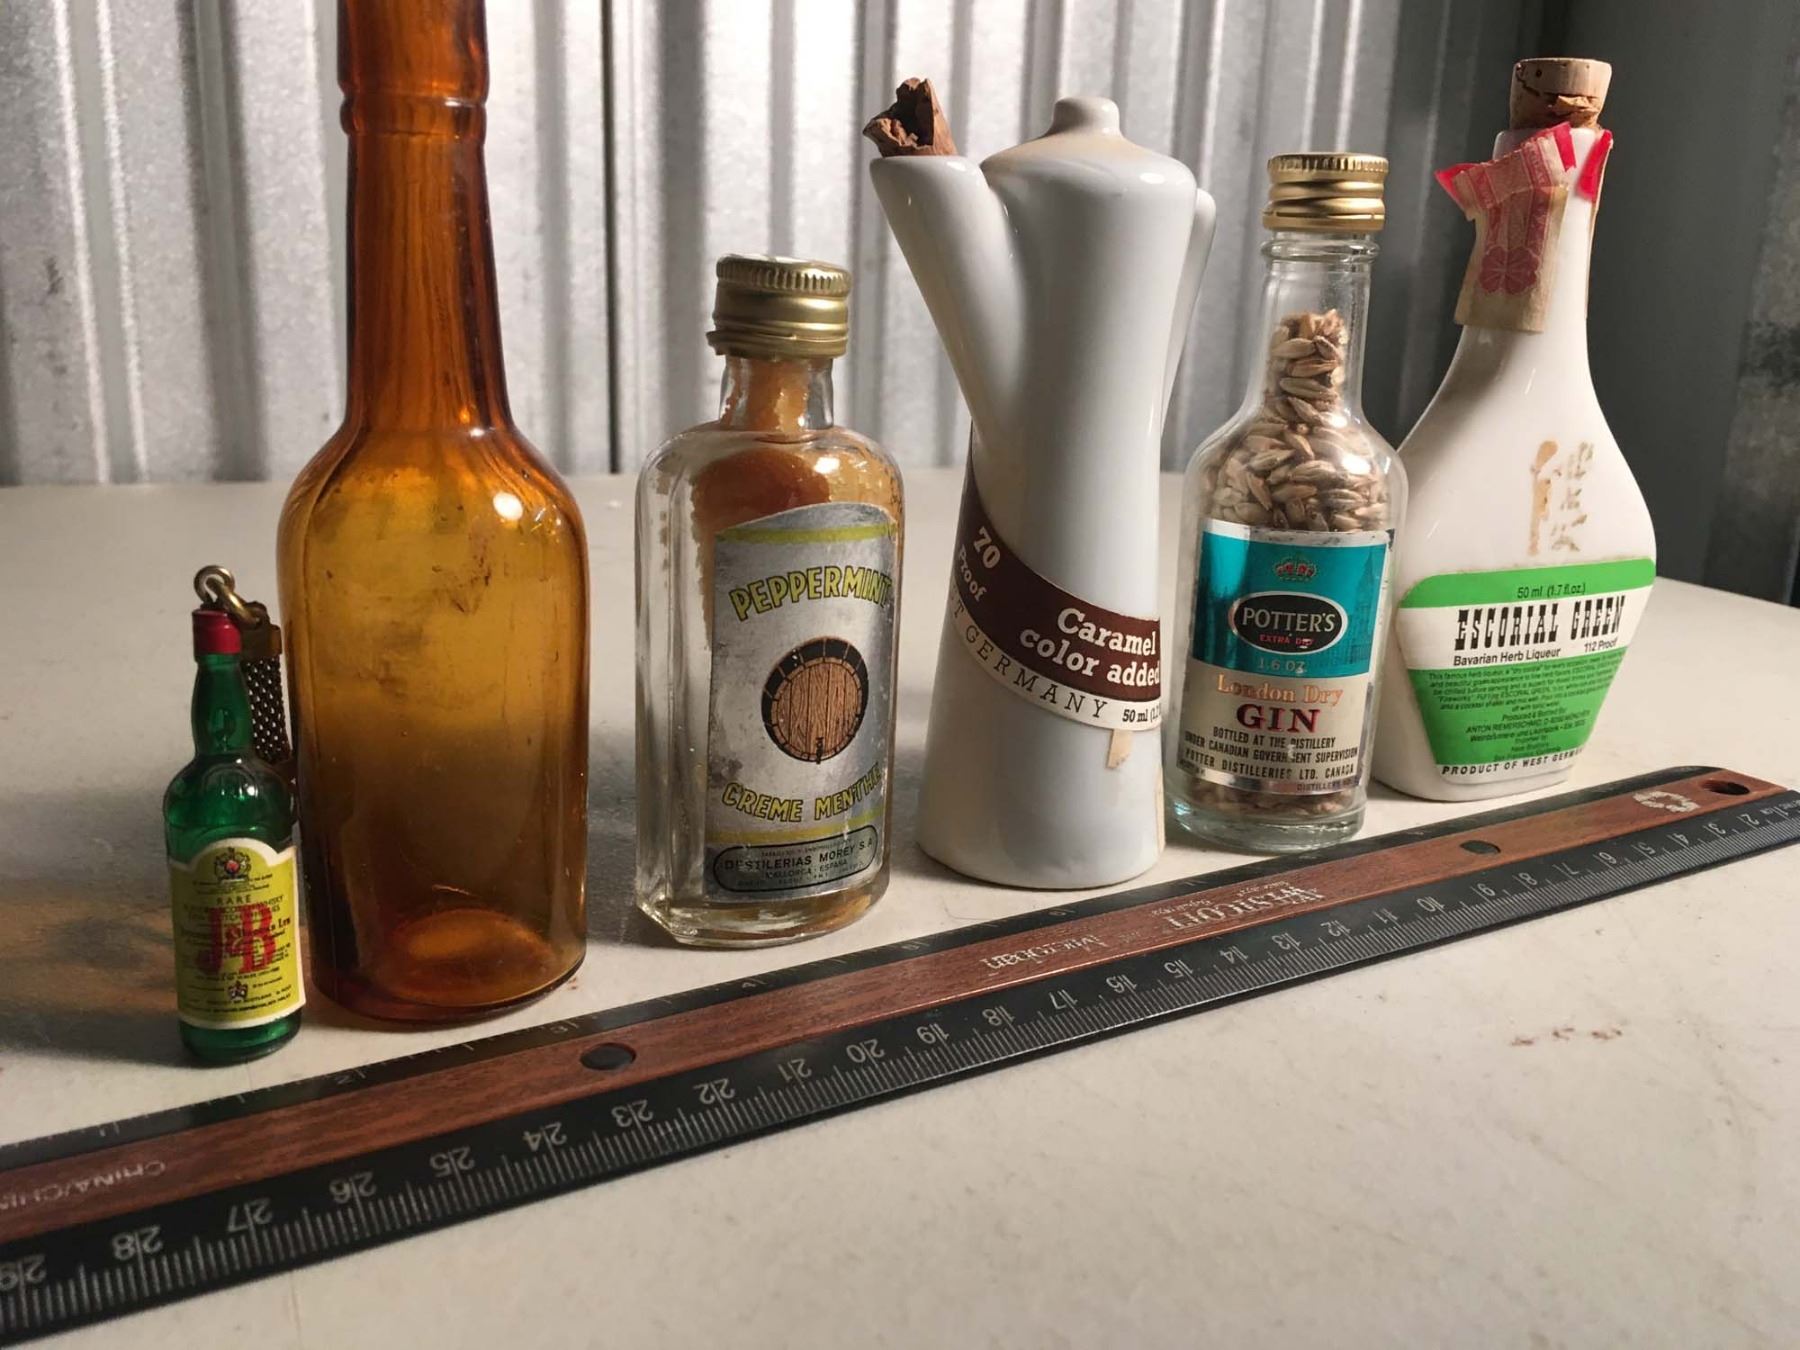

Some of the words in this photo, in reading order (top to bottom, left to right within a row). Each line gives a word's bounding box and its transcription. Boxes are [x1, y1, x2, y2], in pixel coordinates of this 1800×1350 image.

[973, 526, 1001, 569] 70
[958, 545, 987, 601] Proof
[728, 565, 893, 622] PEPPERMINT
[1517, 587, 1529, 598] 50
[1531, 586, 1543, 597] ml
[1242, 607, 1336, 632] POTTER'S
[1454, 603, 1558, 650] ESCORIAL
[1571, 595, 1626, 640] GREEN
[1057, 608, 1157, 656] Caramel
[1260, 634, 1291, 645] EXTRA
[1019, 629, 1100, 677] color
[1453, 654, 1498, 666] Bavarian
[1500, 652, 1523, 663] Herb
[1526, 648, 1561, 662] Liqueur
[1584, 640, 1597, 652] 112
[965, 625, 1108, 718] GERMANY
[1122, 709, 1136, 722] 50
[1136, 708, 1148, 722] ml
[1217, 673, 1296, 702] London
[1304, 685, 1345, 707] Dry
[1236, 703, 1321, 733] GIN
[1185, 730, 1205, 748] UNDER
[1208, 740, 1249, 758] CANADIAN
[1315, 747, 1358, 763] SUPERVISION
[1213, 726, 1249, 744] BOTTLED
[1252, 735, 1264, 746] AT
[1270, 737, 1286, 748] THE
[1186, 748, 1215, 767] POTTER
[1300, 768, 1318, 780] LTD.
[1442, 763, 1500, 775] PRODUCT
[1504, 761, 1518, 771] OF
[1523, 756, 1549, 768] WEST
[722, 782, 804, 822] CREME
[814, 763, 883, 821] MENTHE
[1708, 823, 1726, 835] 3
[1740, 813, 1759, 825] 2
[1638, 842, 1656, 855] 5
[1673, 833, 1689, 845] 4
[819, 845, 855, 863] MOREY
[1599, 852, 1617, 865] 6
[1519, 872, 1537, 886] 8
[1561, 862, 1579, 876] 7
[1478, 882, 1496, 897] 9
[1416, 896, 1446, 913] 10
[1321, 920, 1351, 938] 12
[1272, 932, 1301, 950] 13
[1220, 945, 1249, 964] 14
[1164, 958, 1194, 979] 15
[1050, 989, 1078, 1010] 17
[982, 1005, 1016, 1026] 18
[916, 1023, 950, 1045] 19
[846, 1038, 885, 1063] 20
[778, 1058, 812, 1082] 21
[694, 1078, 736, 1104] 22
[611, 1099, 655, 1127] 23
[523, 1122, 568, 1150] 24
[430, 1146, 475, 1178] 25
[330, 1172, 378, 1203] 26
[227, 1199, 274, 1233] 27
[111, 1225, 164, 1260] 28
[0, 1254, 47, 1290] 29
